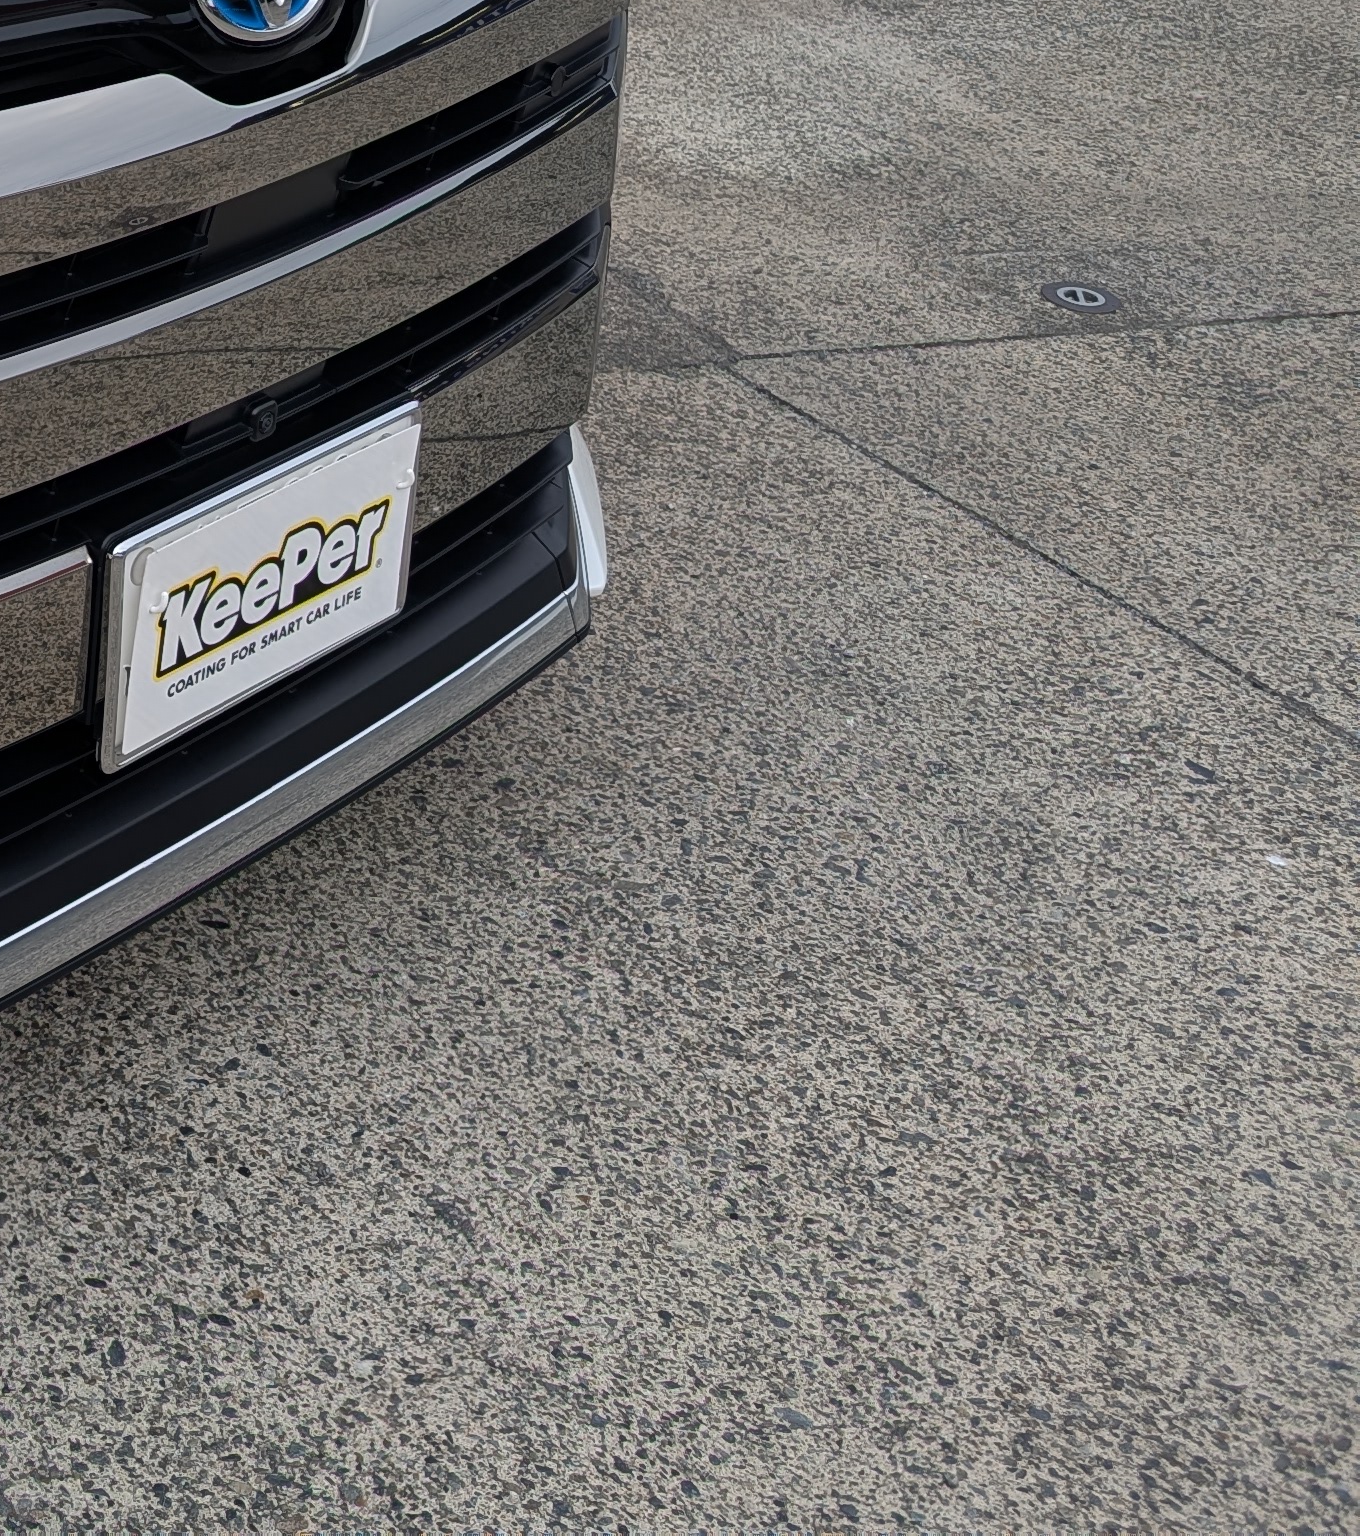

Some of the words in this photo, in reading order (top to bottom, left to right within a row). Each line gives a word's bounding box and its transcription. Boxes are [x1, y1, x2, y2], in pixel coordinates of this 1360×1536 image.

[156, 499, 390, 678] KeePer
[166, 657, 227, 698] COATING
[230, 641, 257, 666] FOR
[259, 616, 304, 650] SMART
[306, 604, 331, 626] CAR
[333, 586, 364, 612] LIFE
